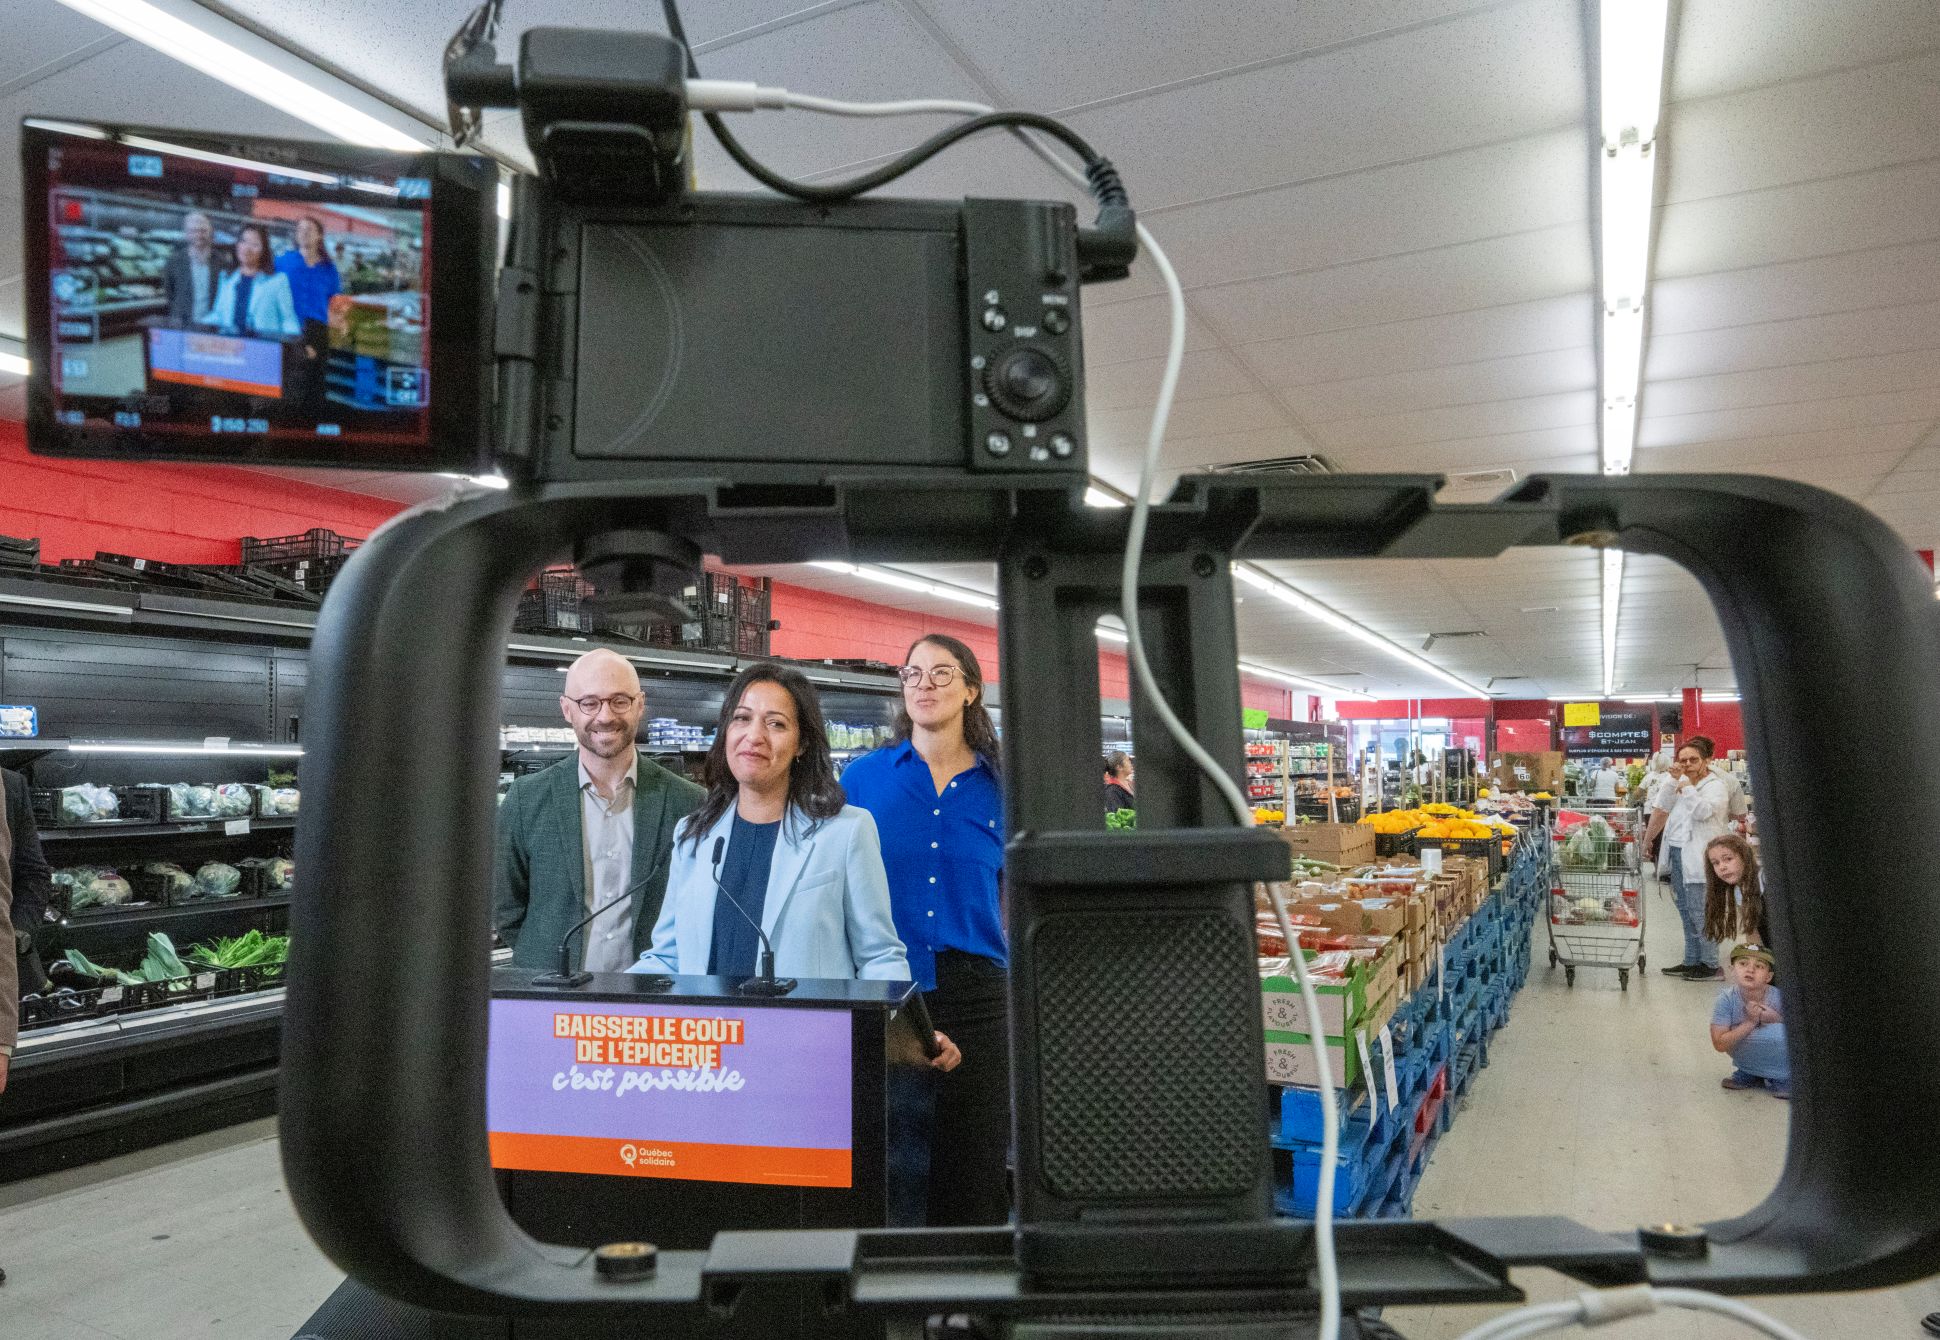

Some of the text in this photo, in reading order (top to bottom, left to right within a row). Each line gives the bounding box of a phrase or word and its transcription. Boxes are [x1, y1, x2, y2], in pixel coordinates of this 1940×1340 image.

[1588, 730, 1649, 738] $COMPTE$
[1272, 998, 1296, 1009] FRESH
[1277, 1007, 1287, 1019] &
[555, 1014, 741, 1043] BAISSER LE COÛT
[577, 1038, 718, 1067] DE L'ÉPICERIE
[1273, 1049, 1296, 1060] FRESH
[1278, 1057, 1288, 1070] &
[552, 1062, 746, 1098] c'est possible
[639, 1147, 673, 1158] Québec
[639, 1157, 676, 1167] solidaire
